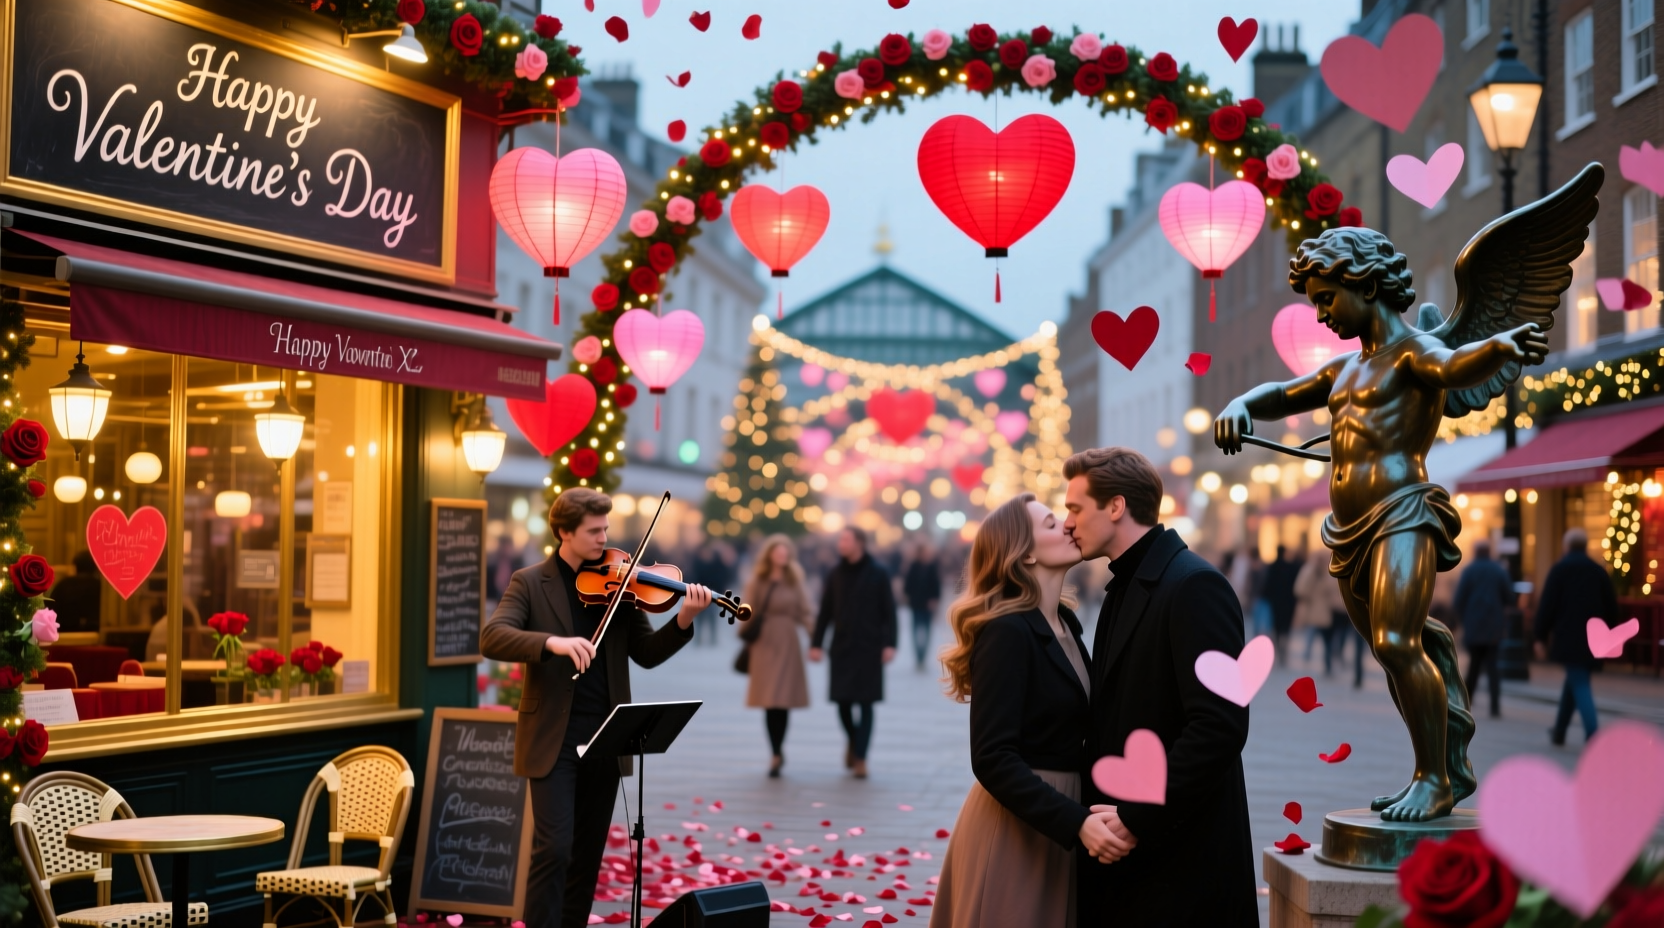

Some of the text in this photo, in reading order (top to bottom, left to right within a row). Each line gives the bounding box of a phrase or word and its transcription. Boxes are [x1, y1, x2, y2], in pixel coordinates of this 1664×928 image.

[177, 43, 321, 148] Happy
[47, 69, 418, 248] Valentine's Day
[269, 321, 332, 370] Happy
